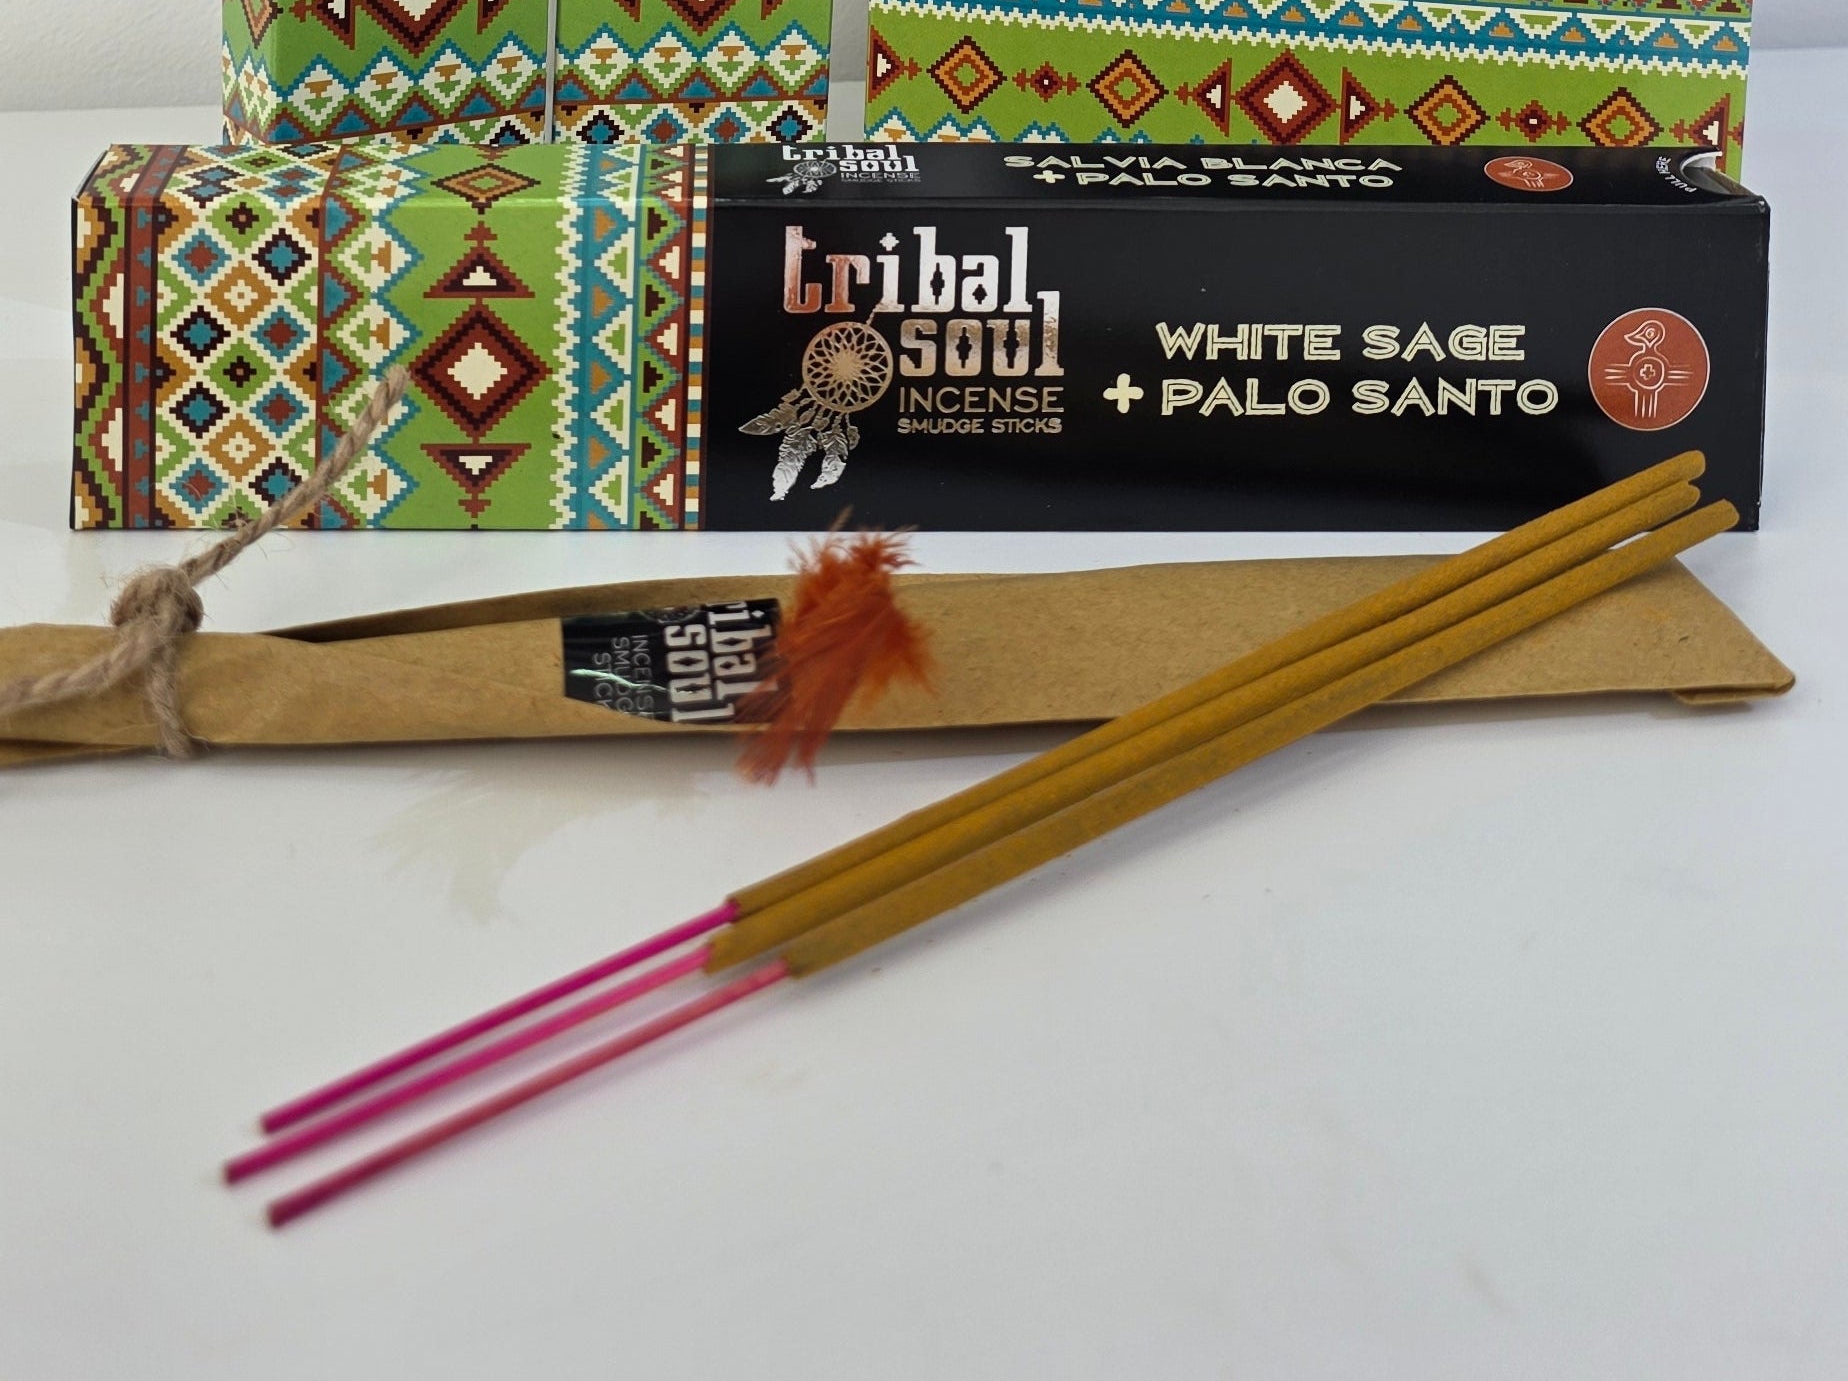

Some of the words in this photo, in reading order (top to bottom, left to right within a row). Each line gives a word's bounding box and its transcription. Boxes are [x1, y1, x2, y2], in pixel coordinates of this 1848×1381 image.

[783, 144, 901, 160] tribal
[839, 155, 919, 171] soul
[1004, 156, 1187, 169] SALVIA
[1201, 158, 1402, 171] BLANCA
[1076, 173, 1211, 185] PALO
[1228, 174, 1393, 187] SANTO
[1665, 175, 1696, 192] PULL
[784, 226, 1033, 314] tribal
[900, 291, 1064, 376] soul
[1156, 322, 1341, 360] WHITE
[1362, 322, 1525, 361] SAGE
[900, 387, 1064, 413] INCENSE
[1161, 377, 1330, 416] PALO
[1352, 377, 1558, 416] SANTO
[898, 418, 984, 434] SMUDGE
[992, 418, 1062, 433] STICKS
[664, 624, 734, 722] soul
